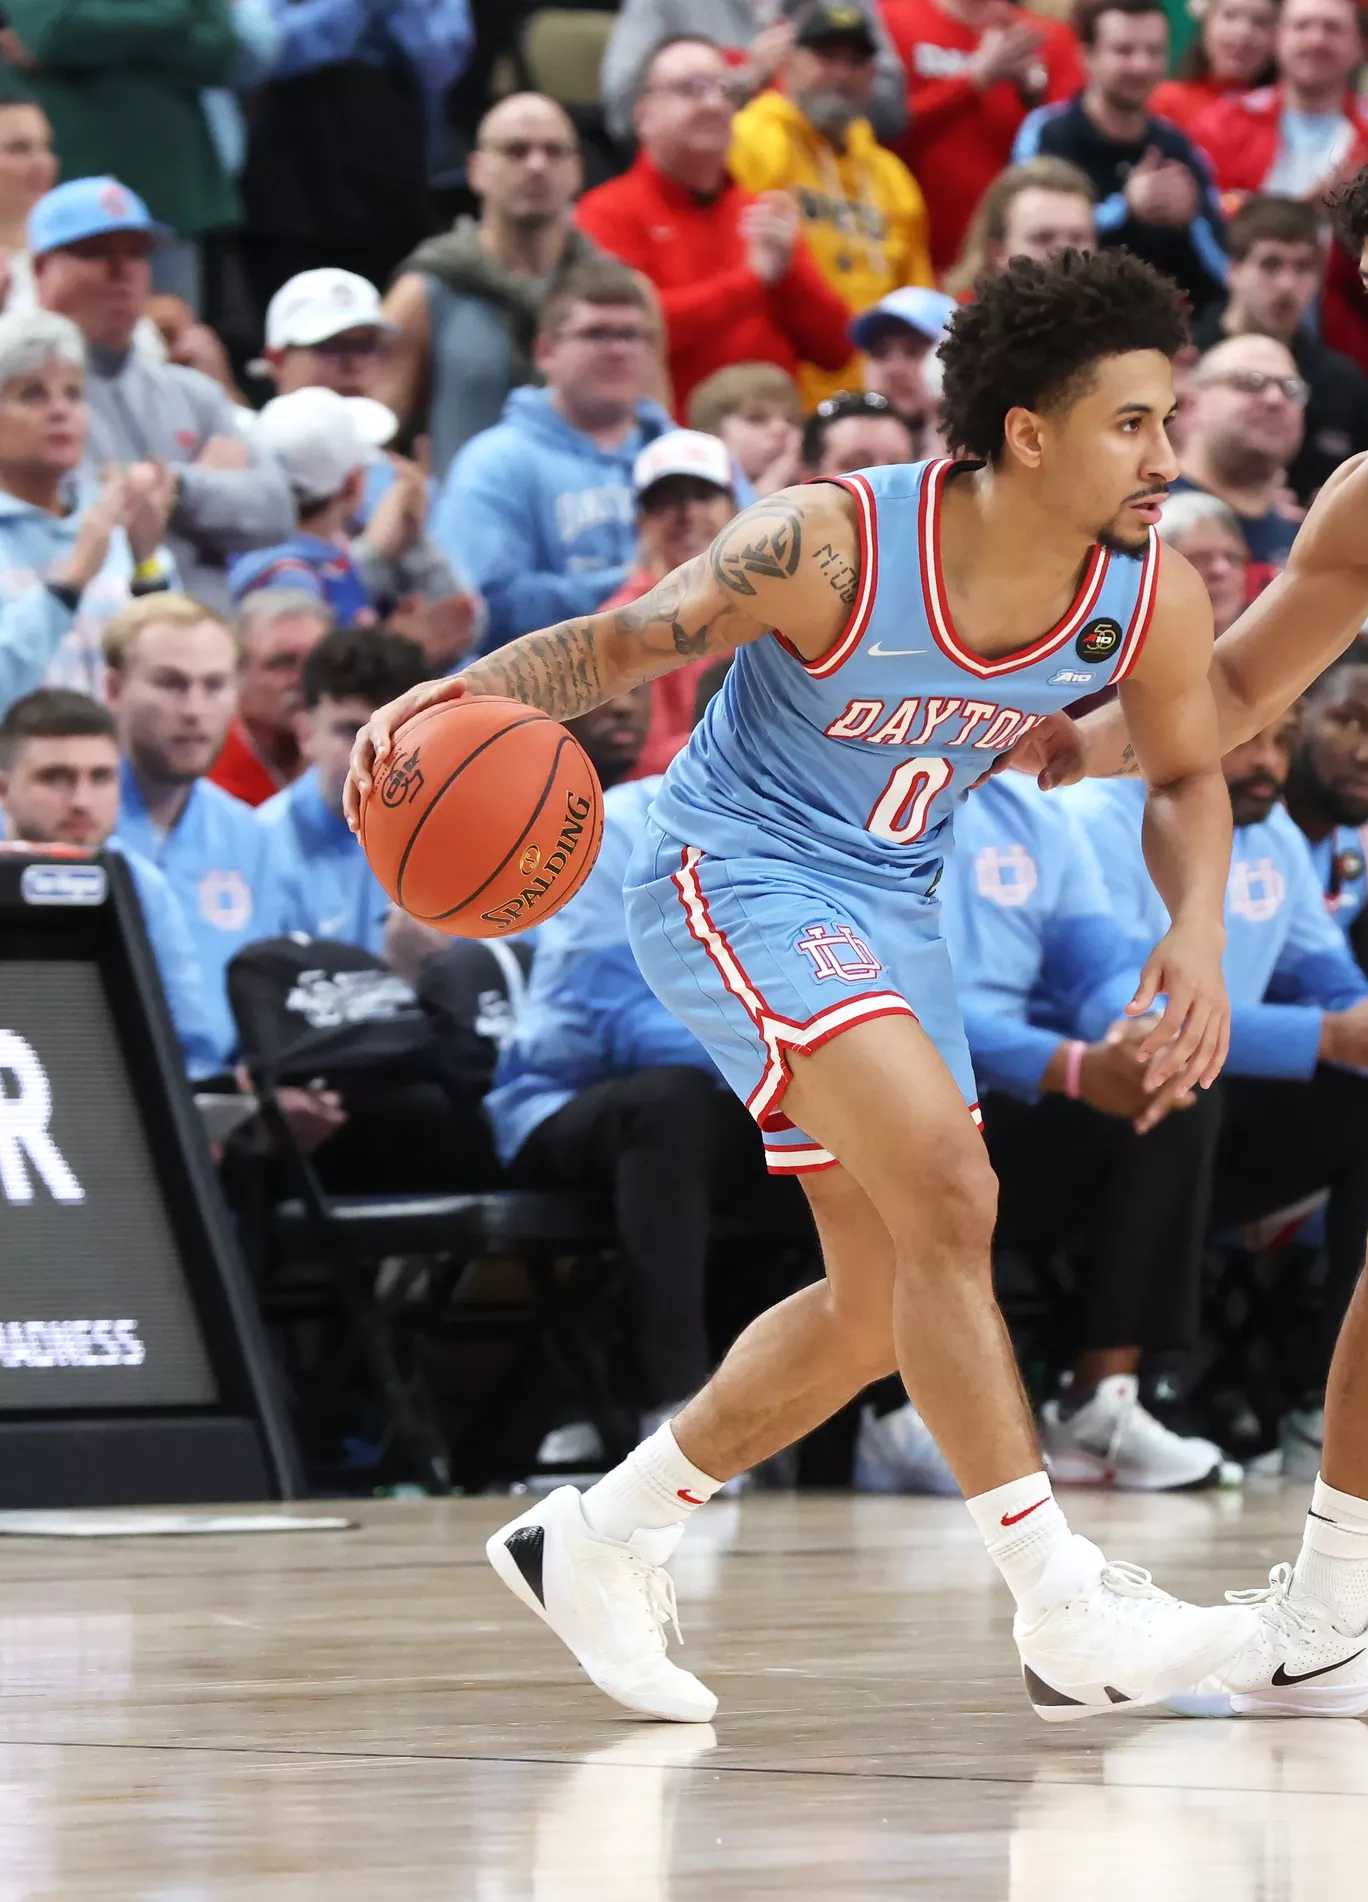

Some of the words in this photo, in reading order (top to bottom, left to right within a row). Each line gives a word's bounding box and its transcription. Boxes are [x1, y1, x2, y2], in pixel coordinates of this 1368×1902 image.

[1052, 672, 1092, 682] A10
[864, 757, 955, 845] 0
[480, 789, 591, 929] SPALDING
[0, 1319, 146, 1368] ADNESS
